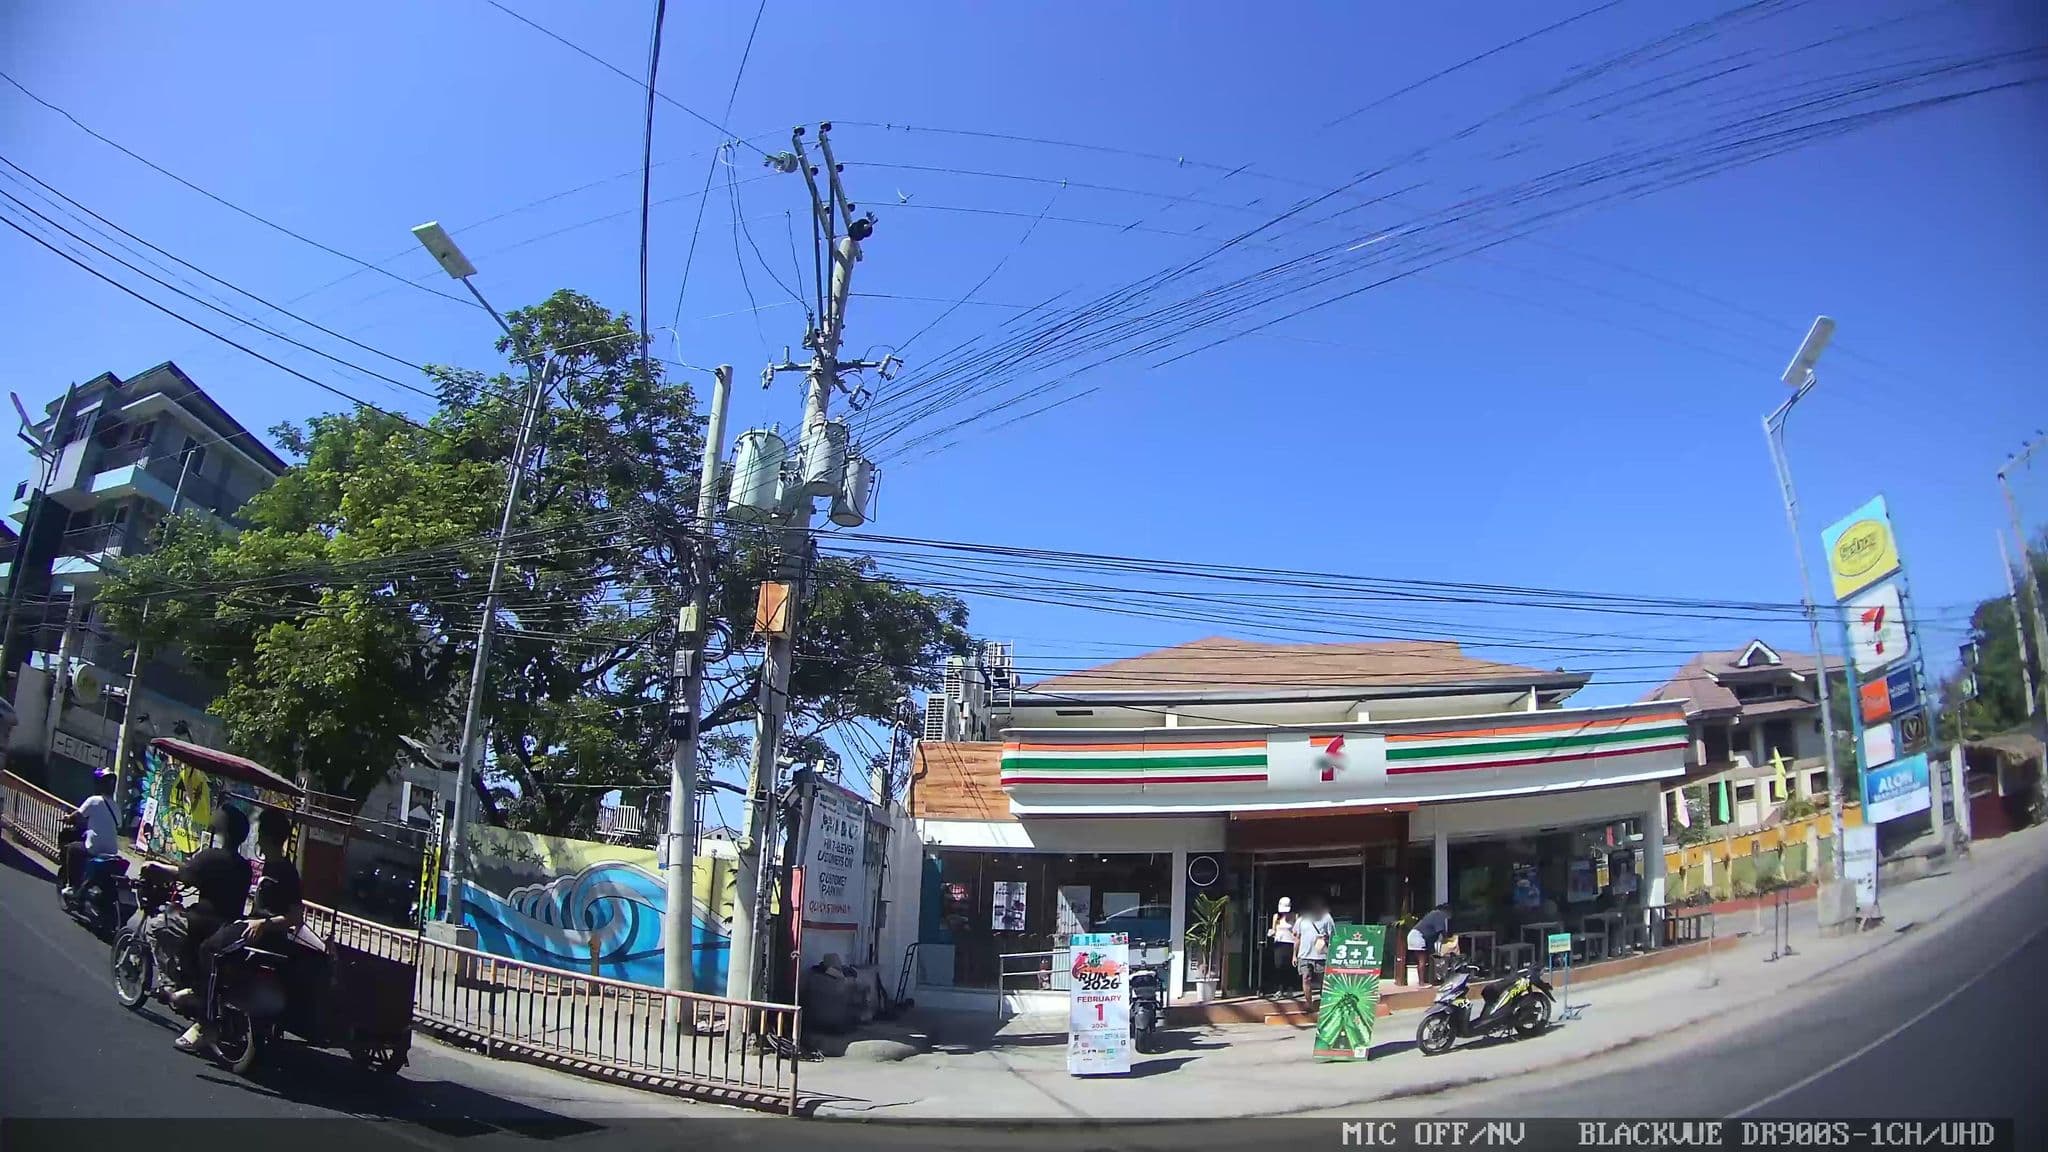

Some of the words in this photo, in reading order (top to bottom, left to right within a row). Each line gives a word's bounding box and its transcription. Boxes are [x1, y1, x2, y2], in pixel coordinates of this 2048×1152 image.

[1079, 971, 1108, 982] RUN
[1082, 978, 1120, 990] 2026
[1077, 995, 1121, 1003] FEBRUARY
[1095, 1003, 1104, 1021] 1
